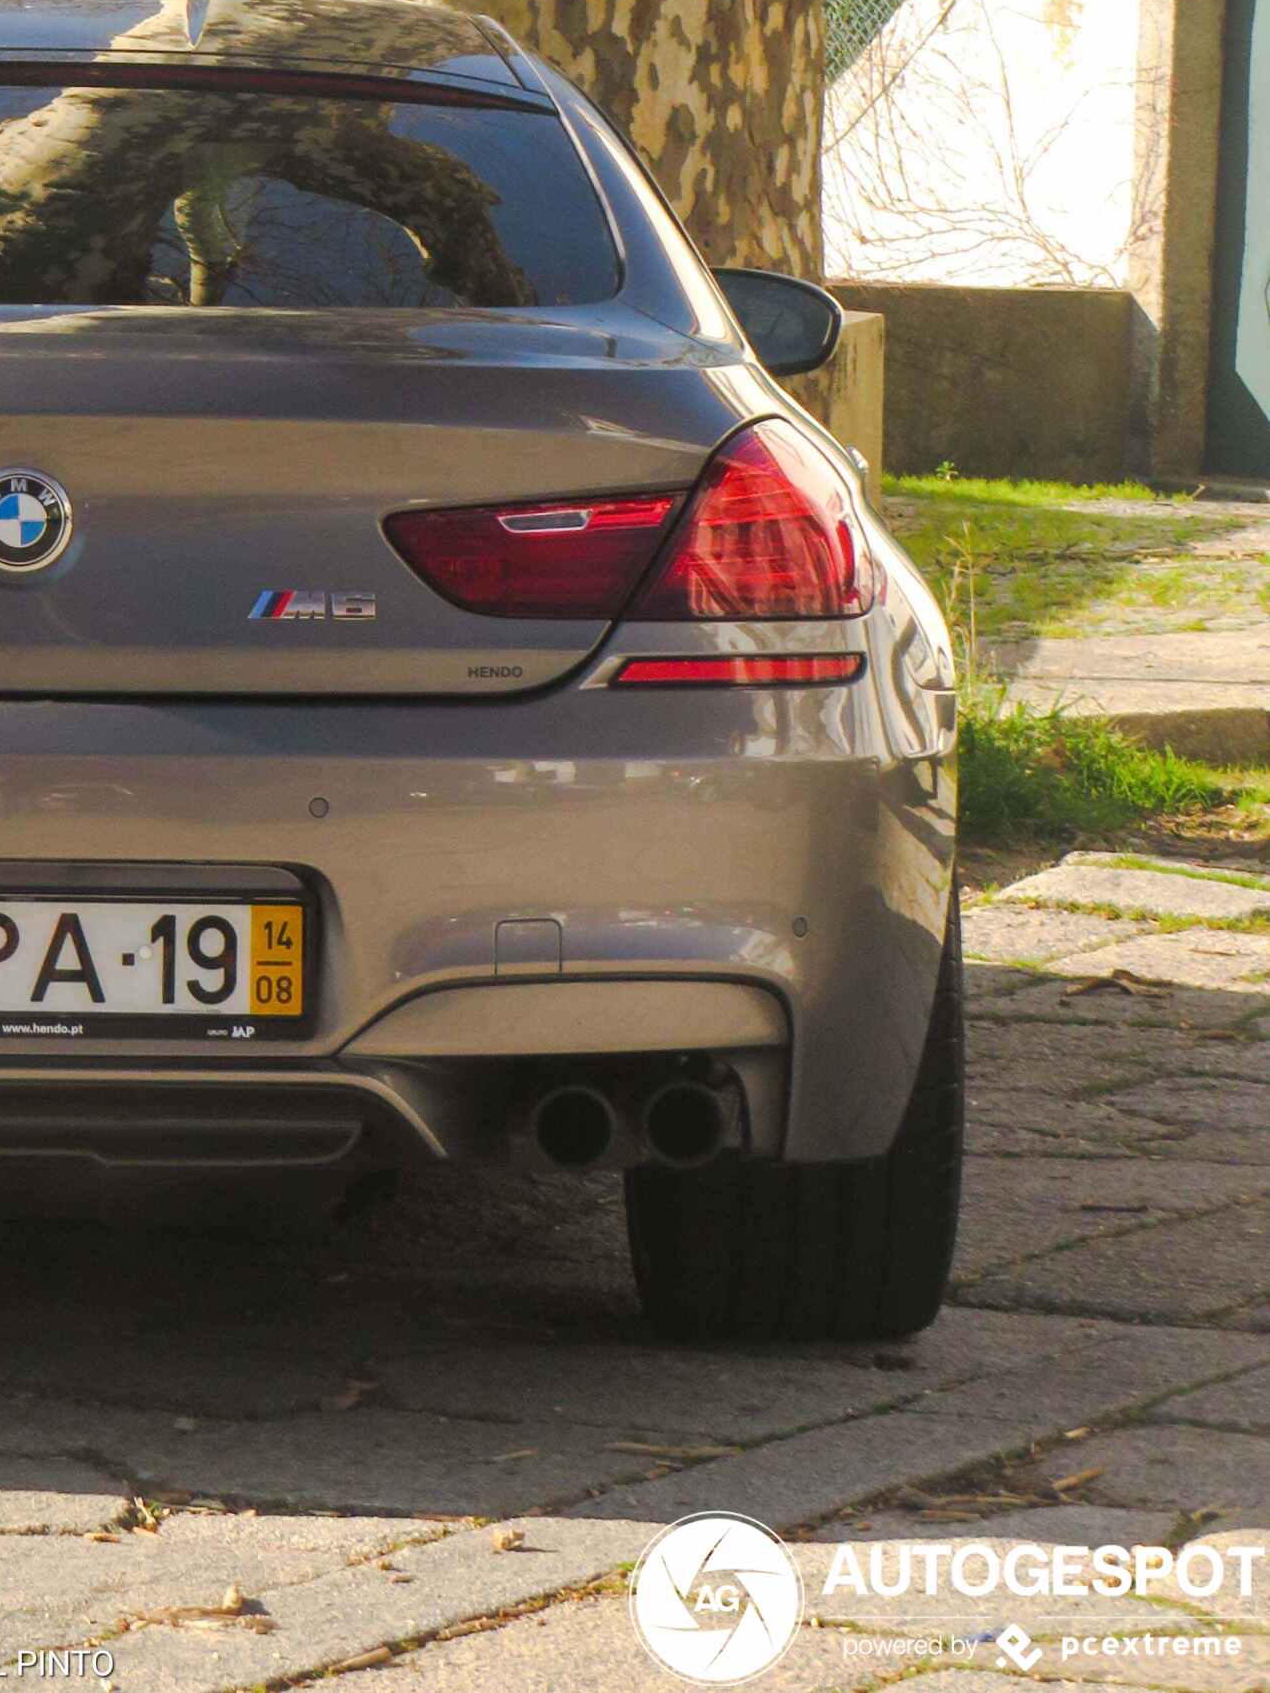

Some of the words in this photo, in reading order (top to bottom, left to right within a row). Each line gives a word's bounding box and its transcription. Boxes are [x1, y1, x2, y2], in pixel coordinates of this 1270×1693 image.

[281, 590, 376, 620] M6
[467, 666, 523, 678] HENDO
[264, 921, 293, 950] 14
[256, 975, 292, 1004] 08
[2, 1022, 84, 1036] www.hendo.pt
